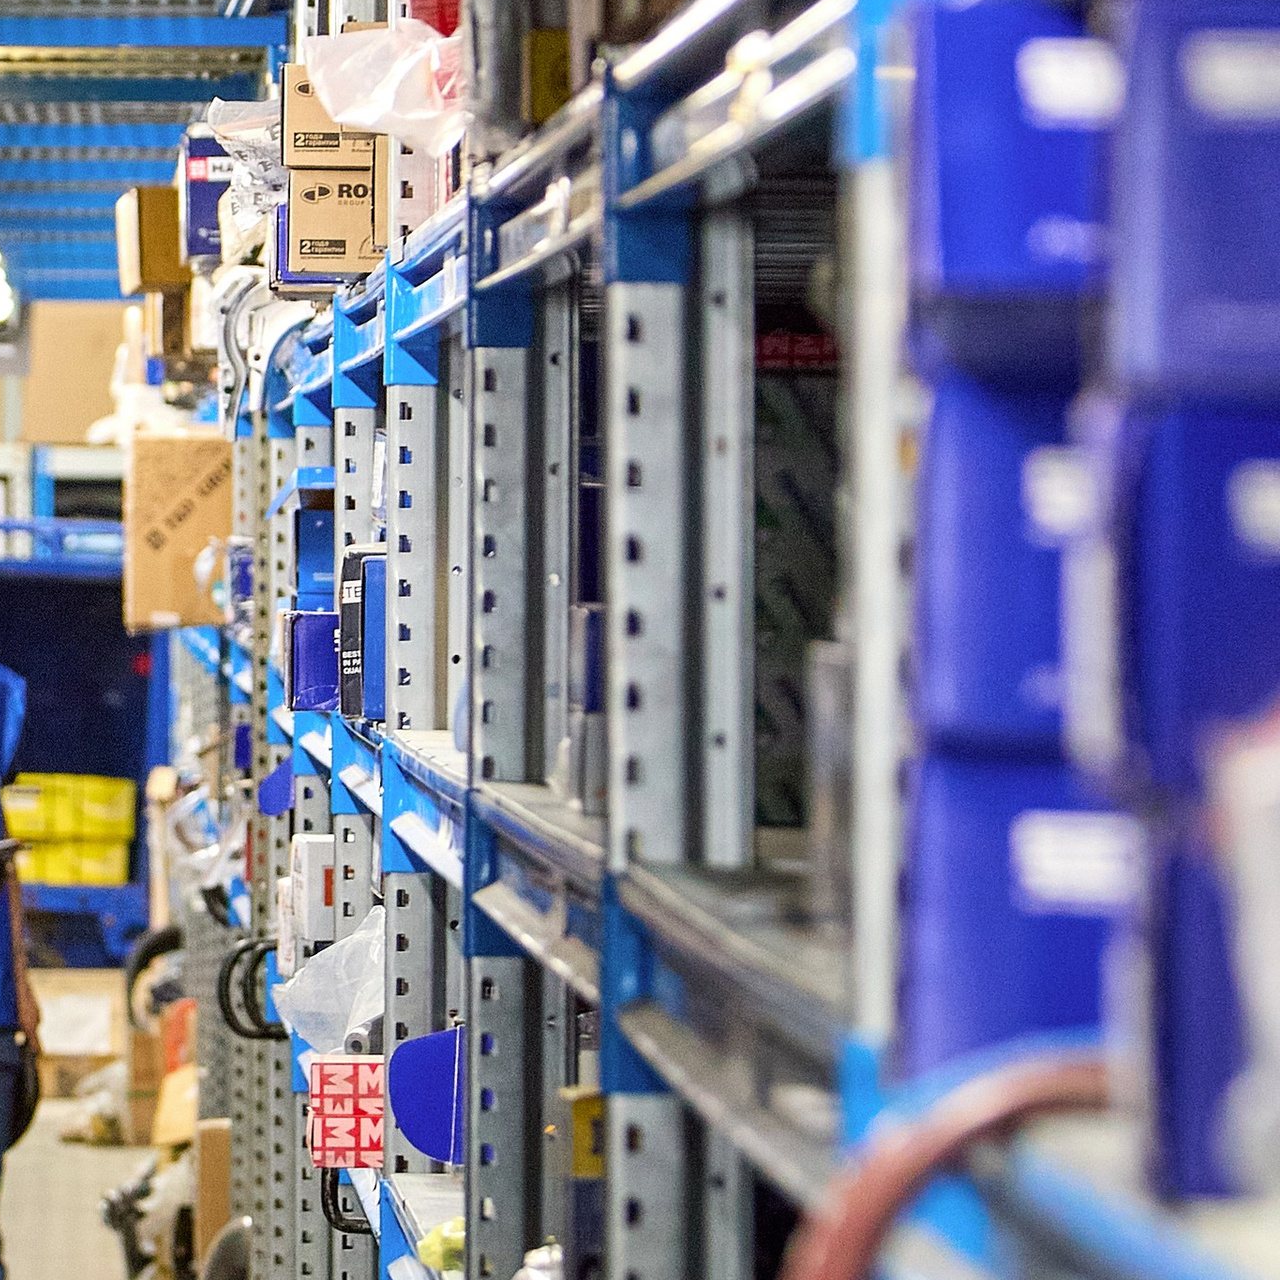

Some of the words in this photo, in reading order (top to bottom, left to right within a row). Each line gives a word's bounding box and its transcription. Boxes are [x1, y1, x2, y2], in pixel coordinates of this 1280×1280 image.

[295, 133, 305, 147] 2
[337, 184, 371, 198] RO
[301, 240, 311, 254] 2
